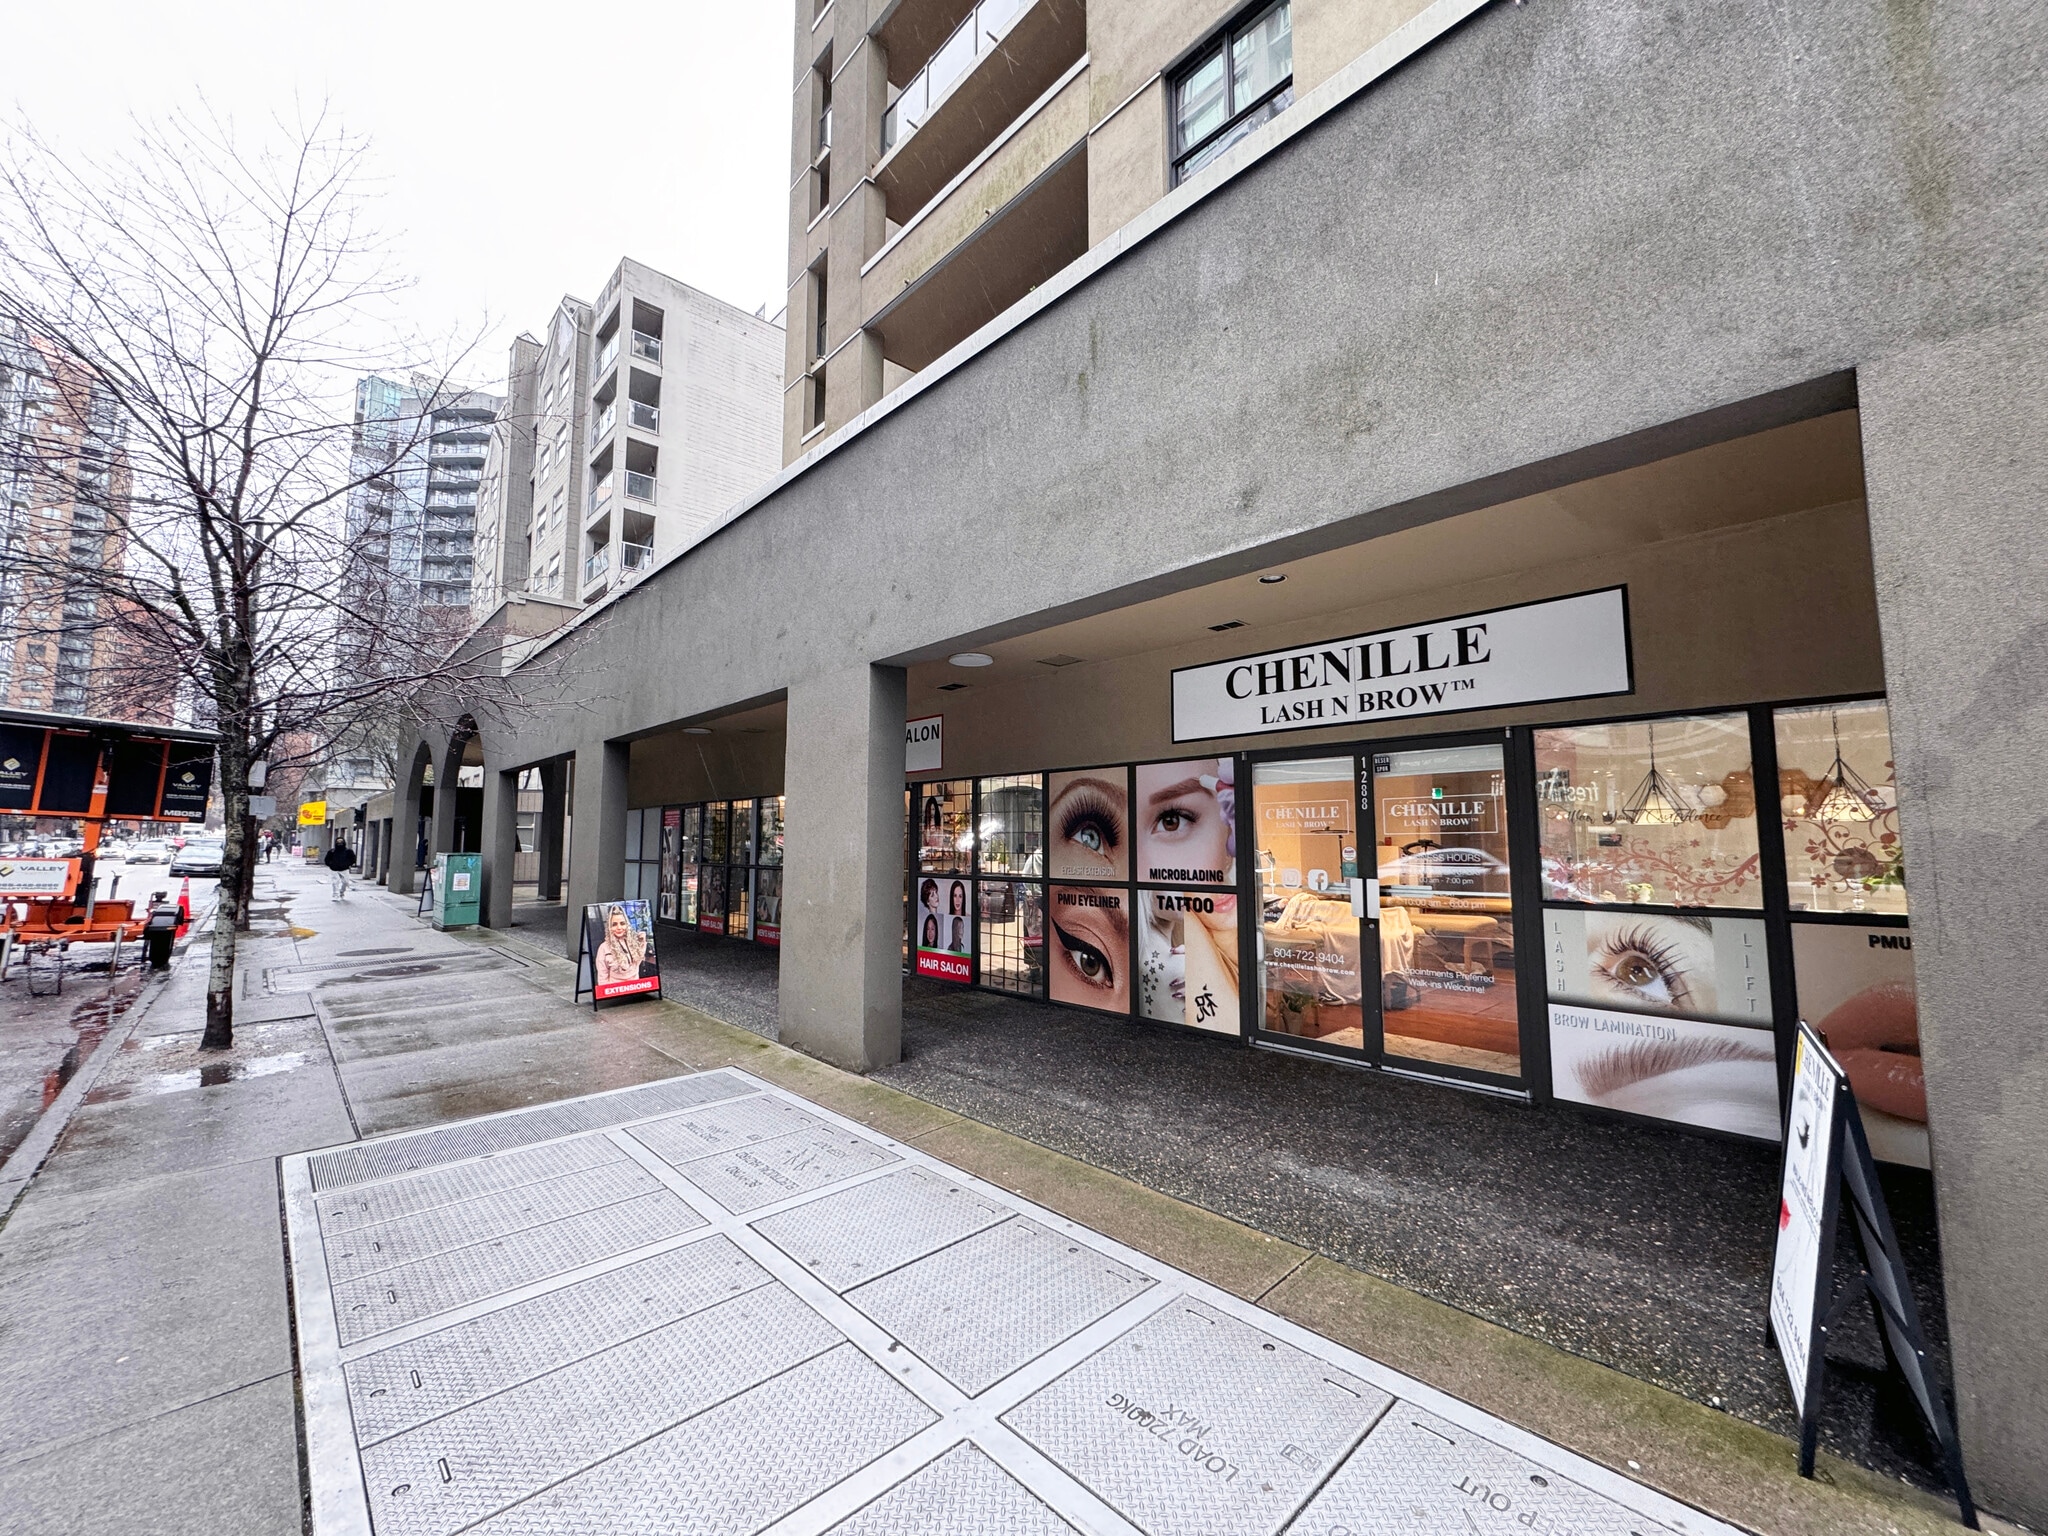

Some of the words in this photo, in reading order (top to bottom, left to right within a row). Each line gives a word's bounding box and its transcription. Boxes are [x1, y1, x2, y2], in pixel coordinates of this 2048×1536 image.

[1225, 623, 1491, 700] CHENILLE
[1260, 699, 1324, 725] LASH
[1331, 695, 1350, 717] N
[905, 723, 940, 744] ALON
[1360, 756, 1368, 811] 1288
[1265, 806, 1340, 820] CHENILLE
[1390, 801, 1485, 819] CHENILLE
[1403, 818, 1429, 827] LASH
[1431, 818, 1438, 826] N
[1446, 854, 1481, 862] HOURS
[1149, 868, 1224, 882] MICROBLADING
[1057, 893, 1077, 905] PMU
[1078, 894, 1120, 909] EYELINER
[1156, 895, 1214, 913] TATTOO
[1868, 934, 1911, 950] PMU
[1273, 947, 1345, 965] 604-722-9404
[1553, 921, 1566, 992] LASH
[919, 956, 939, 971] HAIR
[940, 960, 969, 976] SALON
[1743, 932, 1757, 1012] LIFT
[1408, 978, 1442, 989] Walk-ins
[1443, 981, 1486, 994] Welcome!
[1455, 971, 1495, 983] Preferred
[604, 981, 652, 995] EXTENSIONS
[1553, 1011, 1590, 1030] BROW
[1594, 1017, 1677, 1041] LAMINATION
[1160, 1403, 1211, 1439] MAX
[1178, 1438, 1240, 1482] LOAD
[1453, 1475, 1512, 1513] OUT
